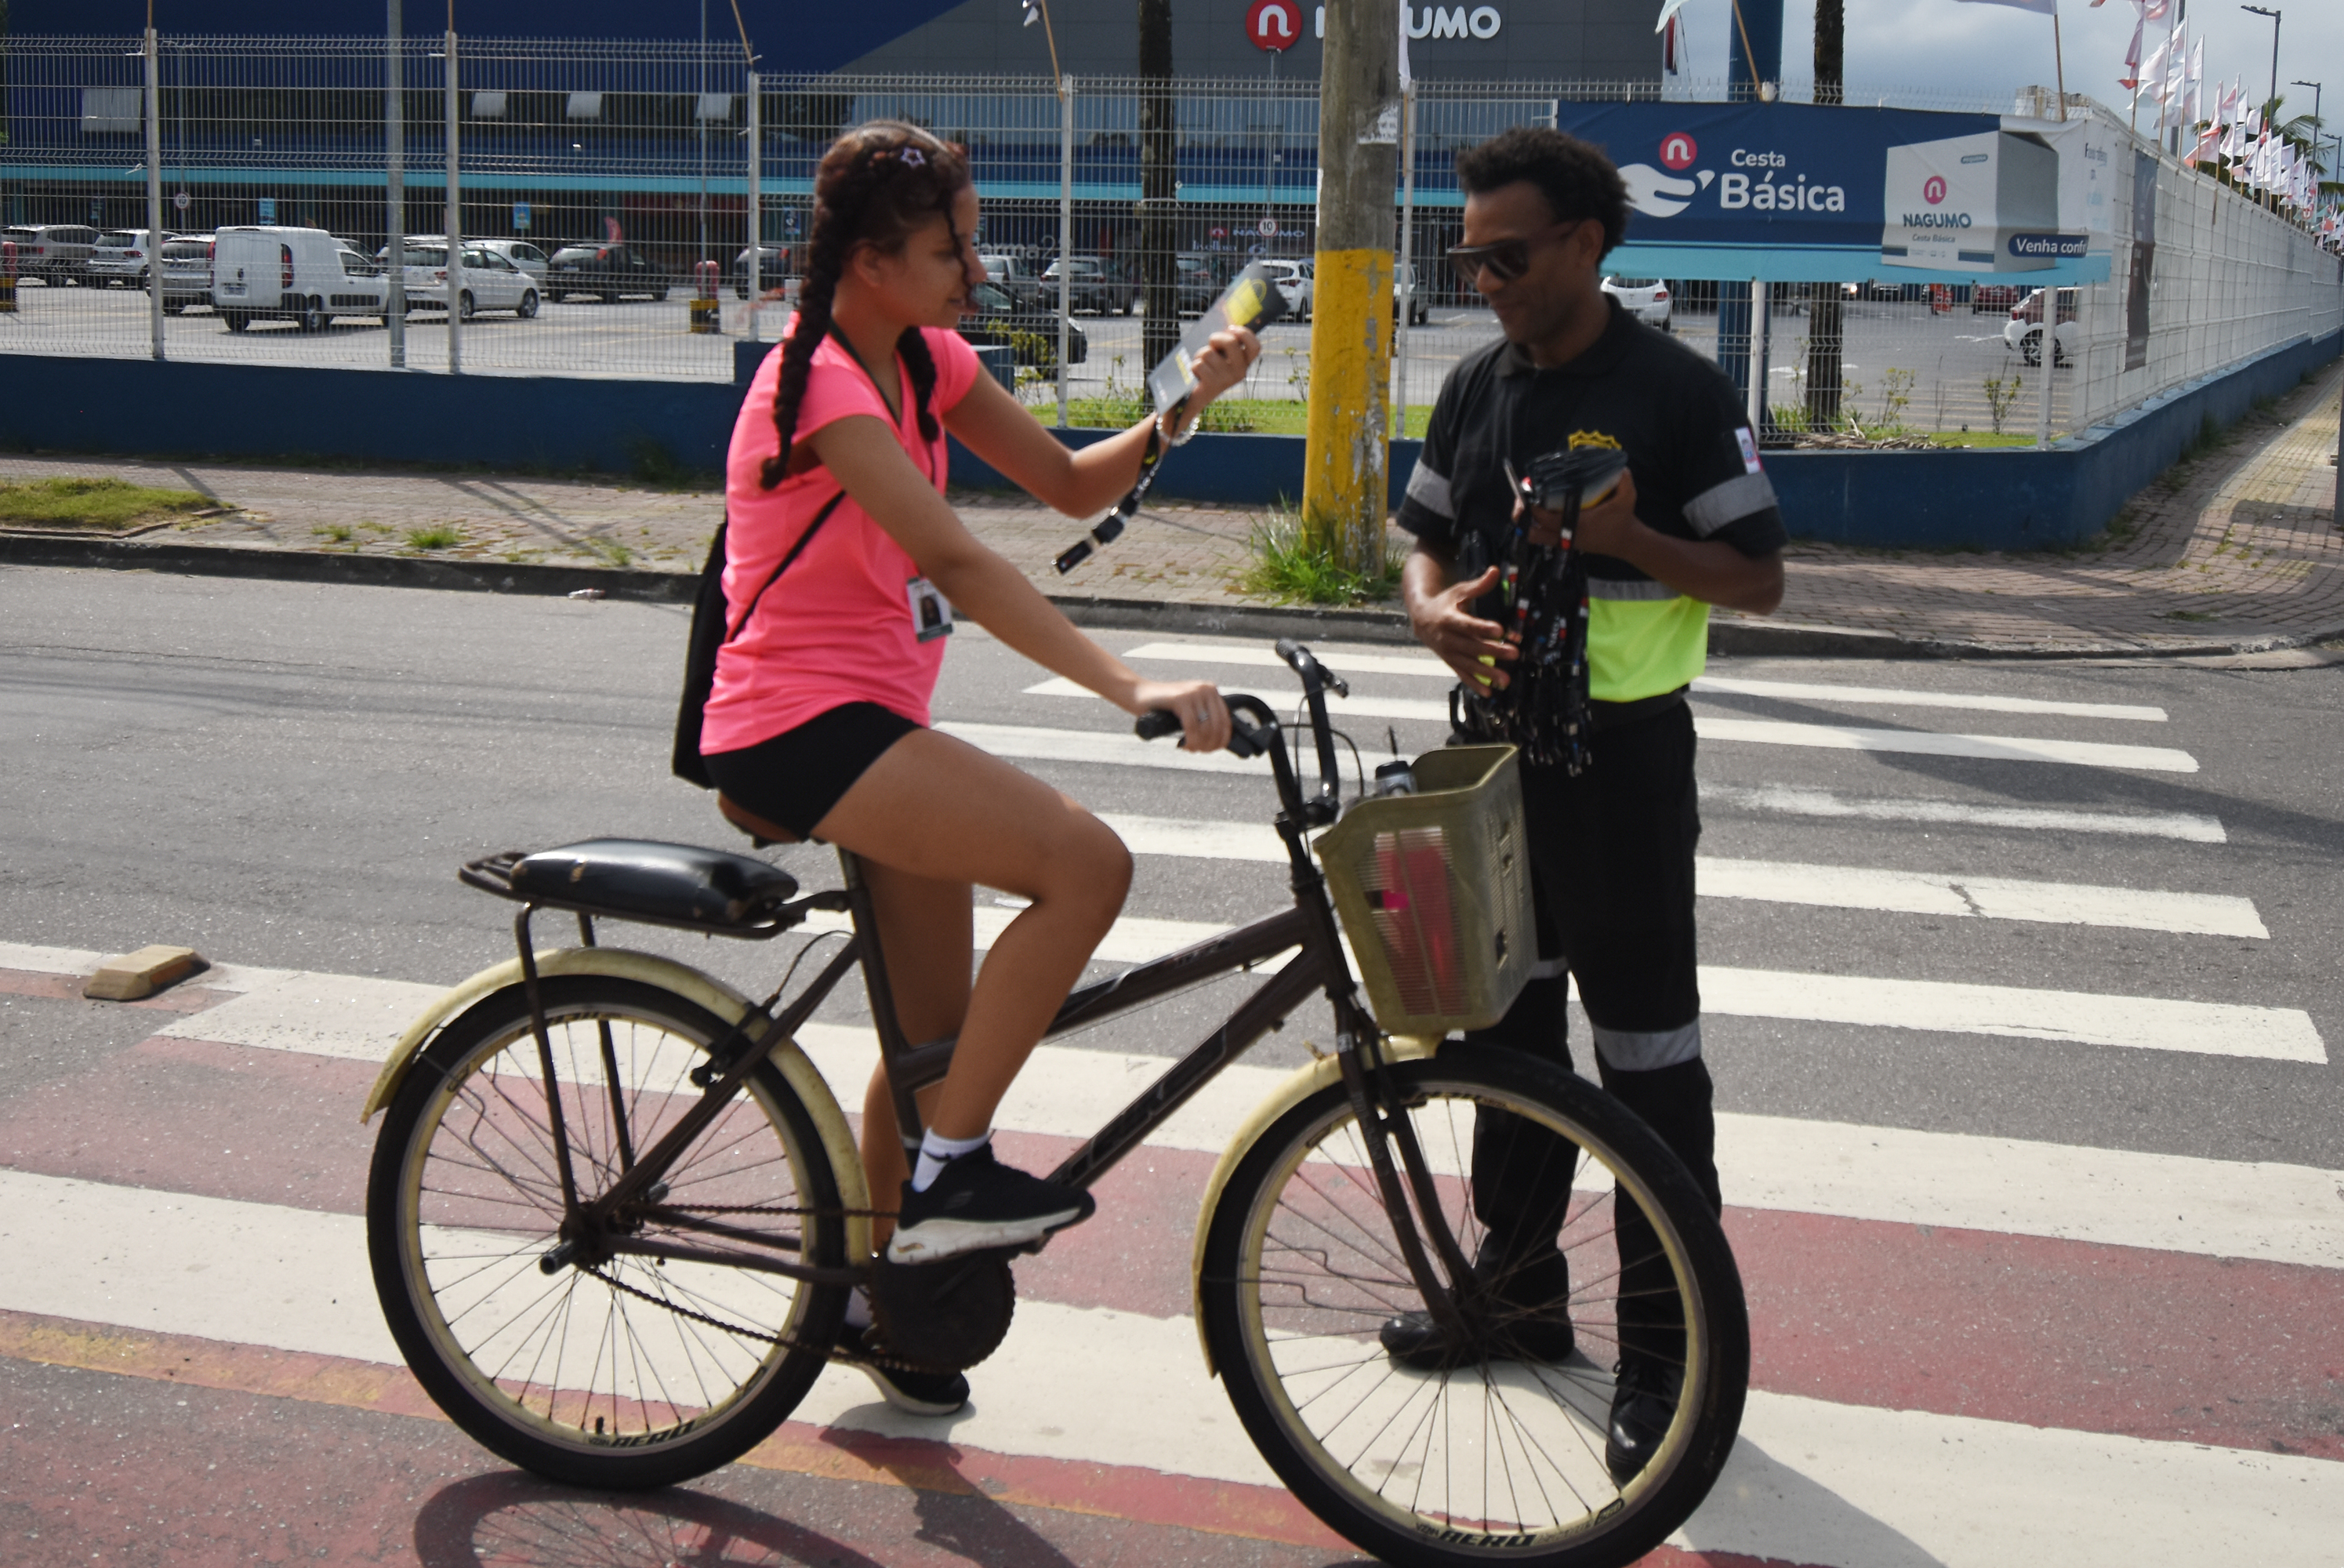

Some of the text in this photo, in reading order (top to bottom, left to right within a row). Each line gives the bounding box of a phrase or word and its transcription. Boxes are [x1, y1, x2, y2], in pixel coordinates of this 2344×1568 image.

[1731, 148, 1786, 168] Cesta
[1720, 170, 1845, 211] Básica
[1263, 221, 1272, 230] 10
[1903, 212, 1972, 229] NAGUMO
[2016, 238, 2058, 254] Venha
